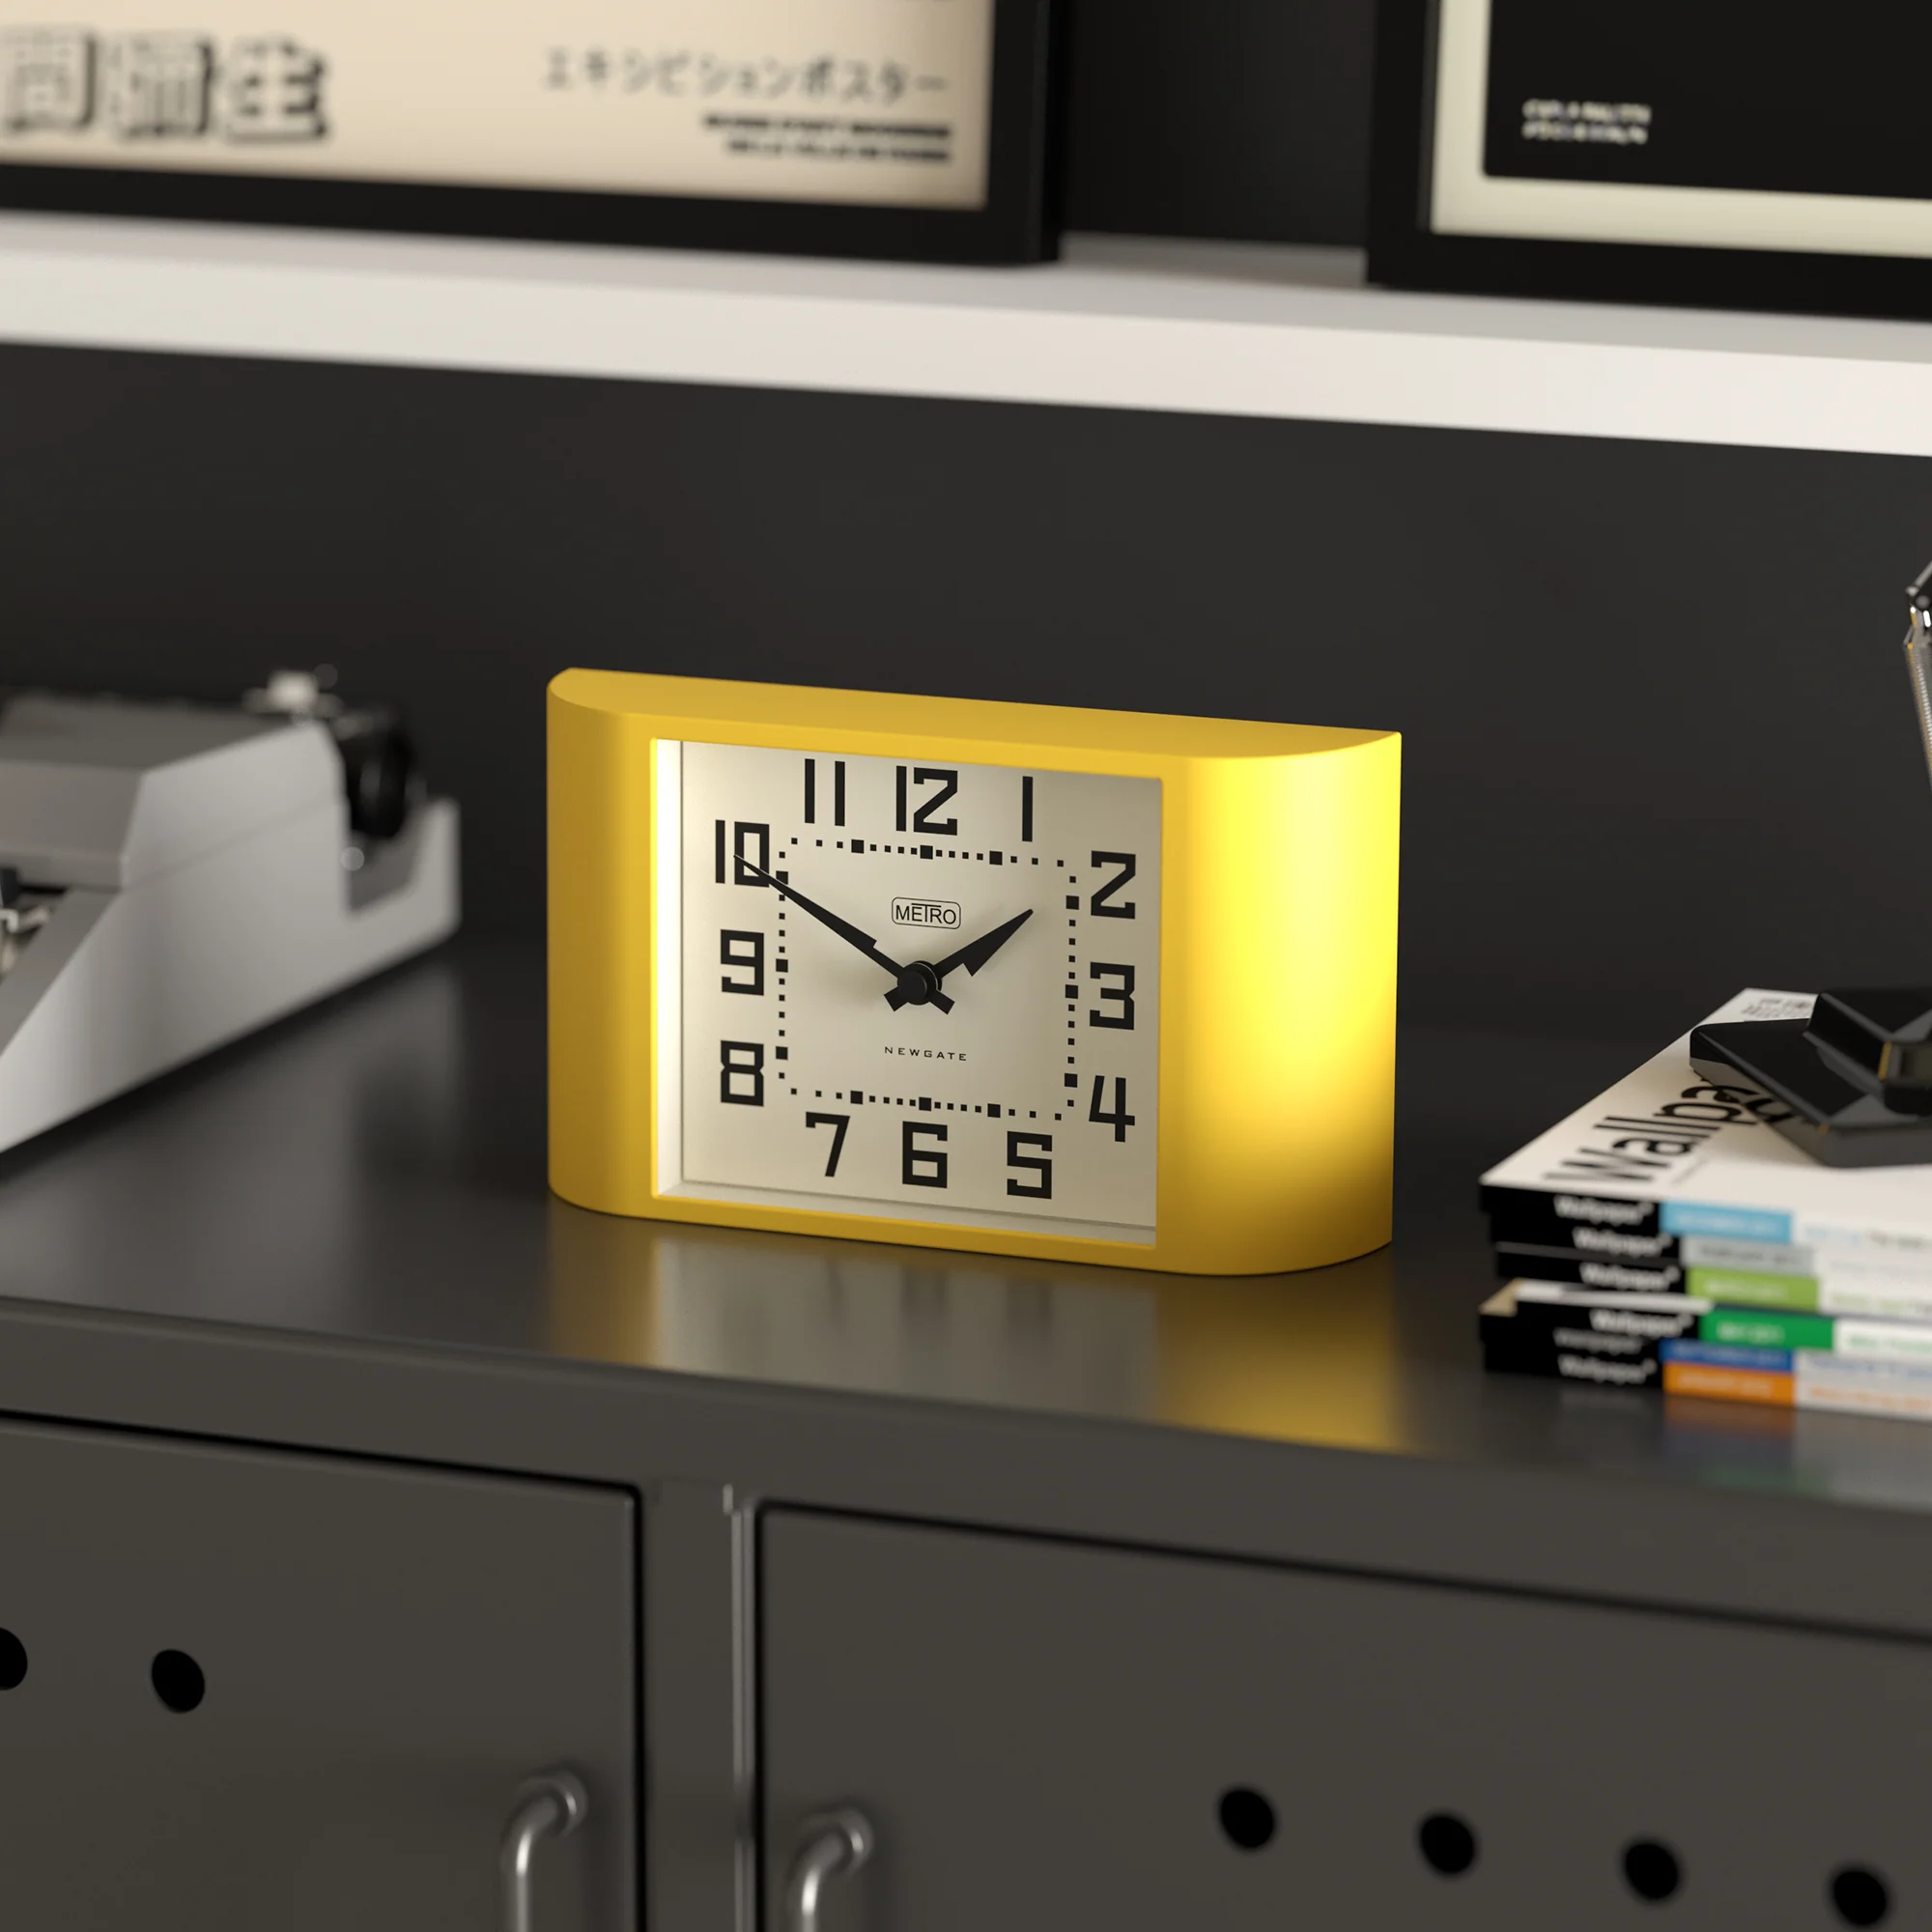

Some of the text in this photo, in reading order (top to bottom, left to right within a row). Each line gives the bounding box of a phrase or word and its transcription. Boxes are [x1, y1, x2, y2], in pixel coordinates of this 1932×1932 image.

[805, 758, 845, 827] 11
[895, 766, 958, 836] 12
[1022, 776, 1034, 842] 1
[715, 819, 770, 888] 10
[1091, 850, 1137, 920] 2
[895, 902, 956, 924] METRO
[720, 929, 765, 996] 9
[1089, 962, 1135, 1031] 3
[720, 1040, 764, 1107] 8
[884, 1046, 967, 1062] NEWGATE
[1088, 1075, 1136, 1143] 4
[806, 1111, 851, 1178] 7
[901, 1121, 949, 1189] 6
[1007, 1130, 1053, 1200] 5
